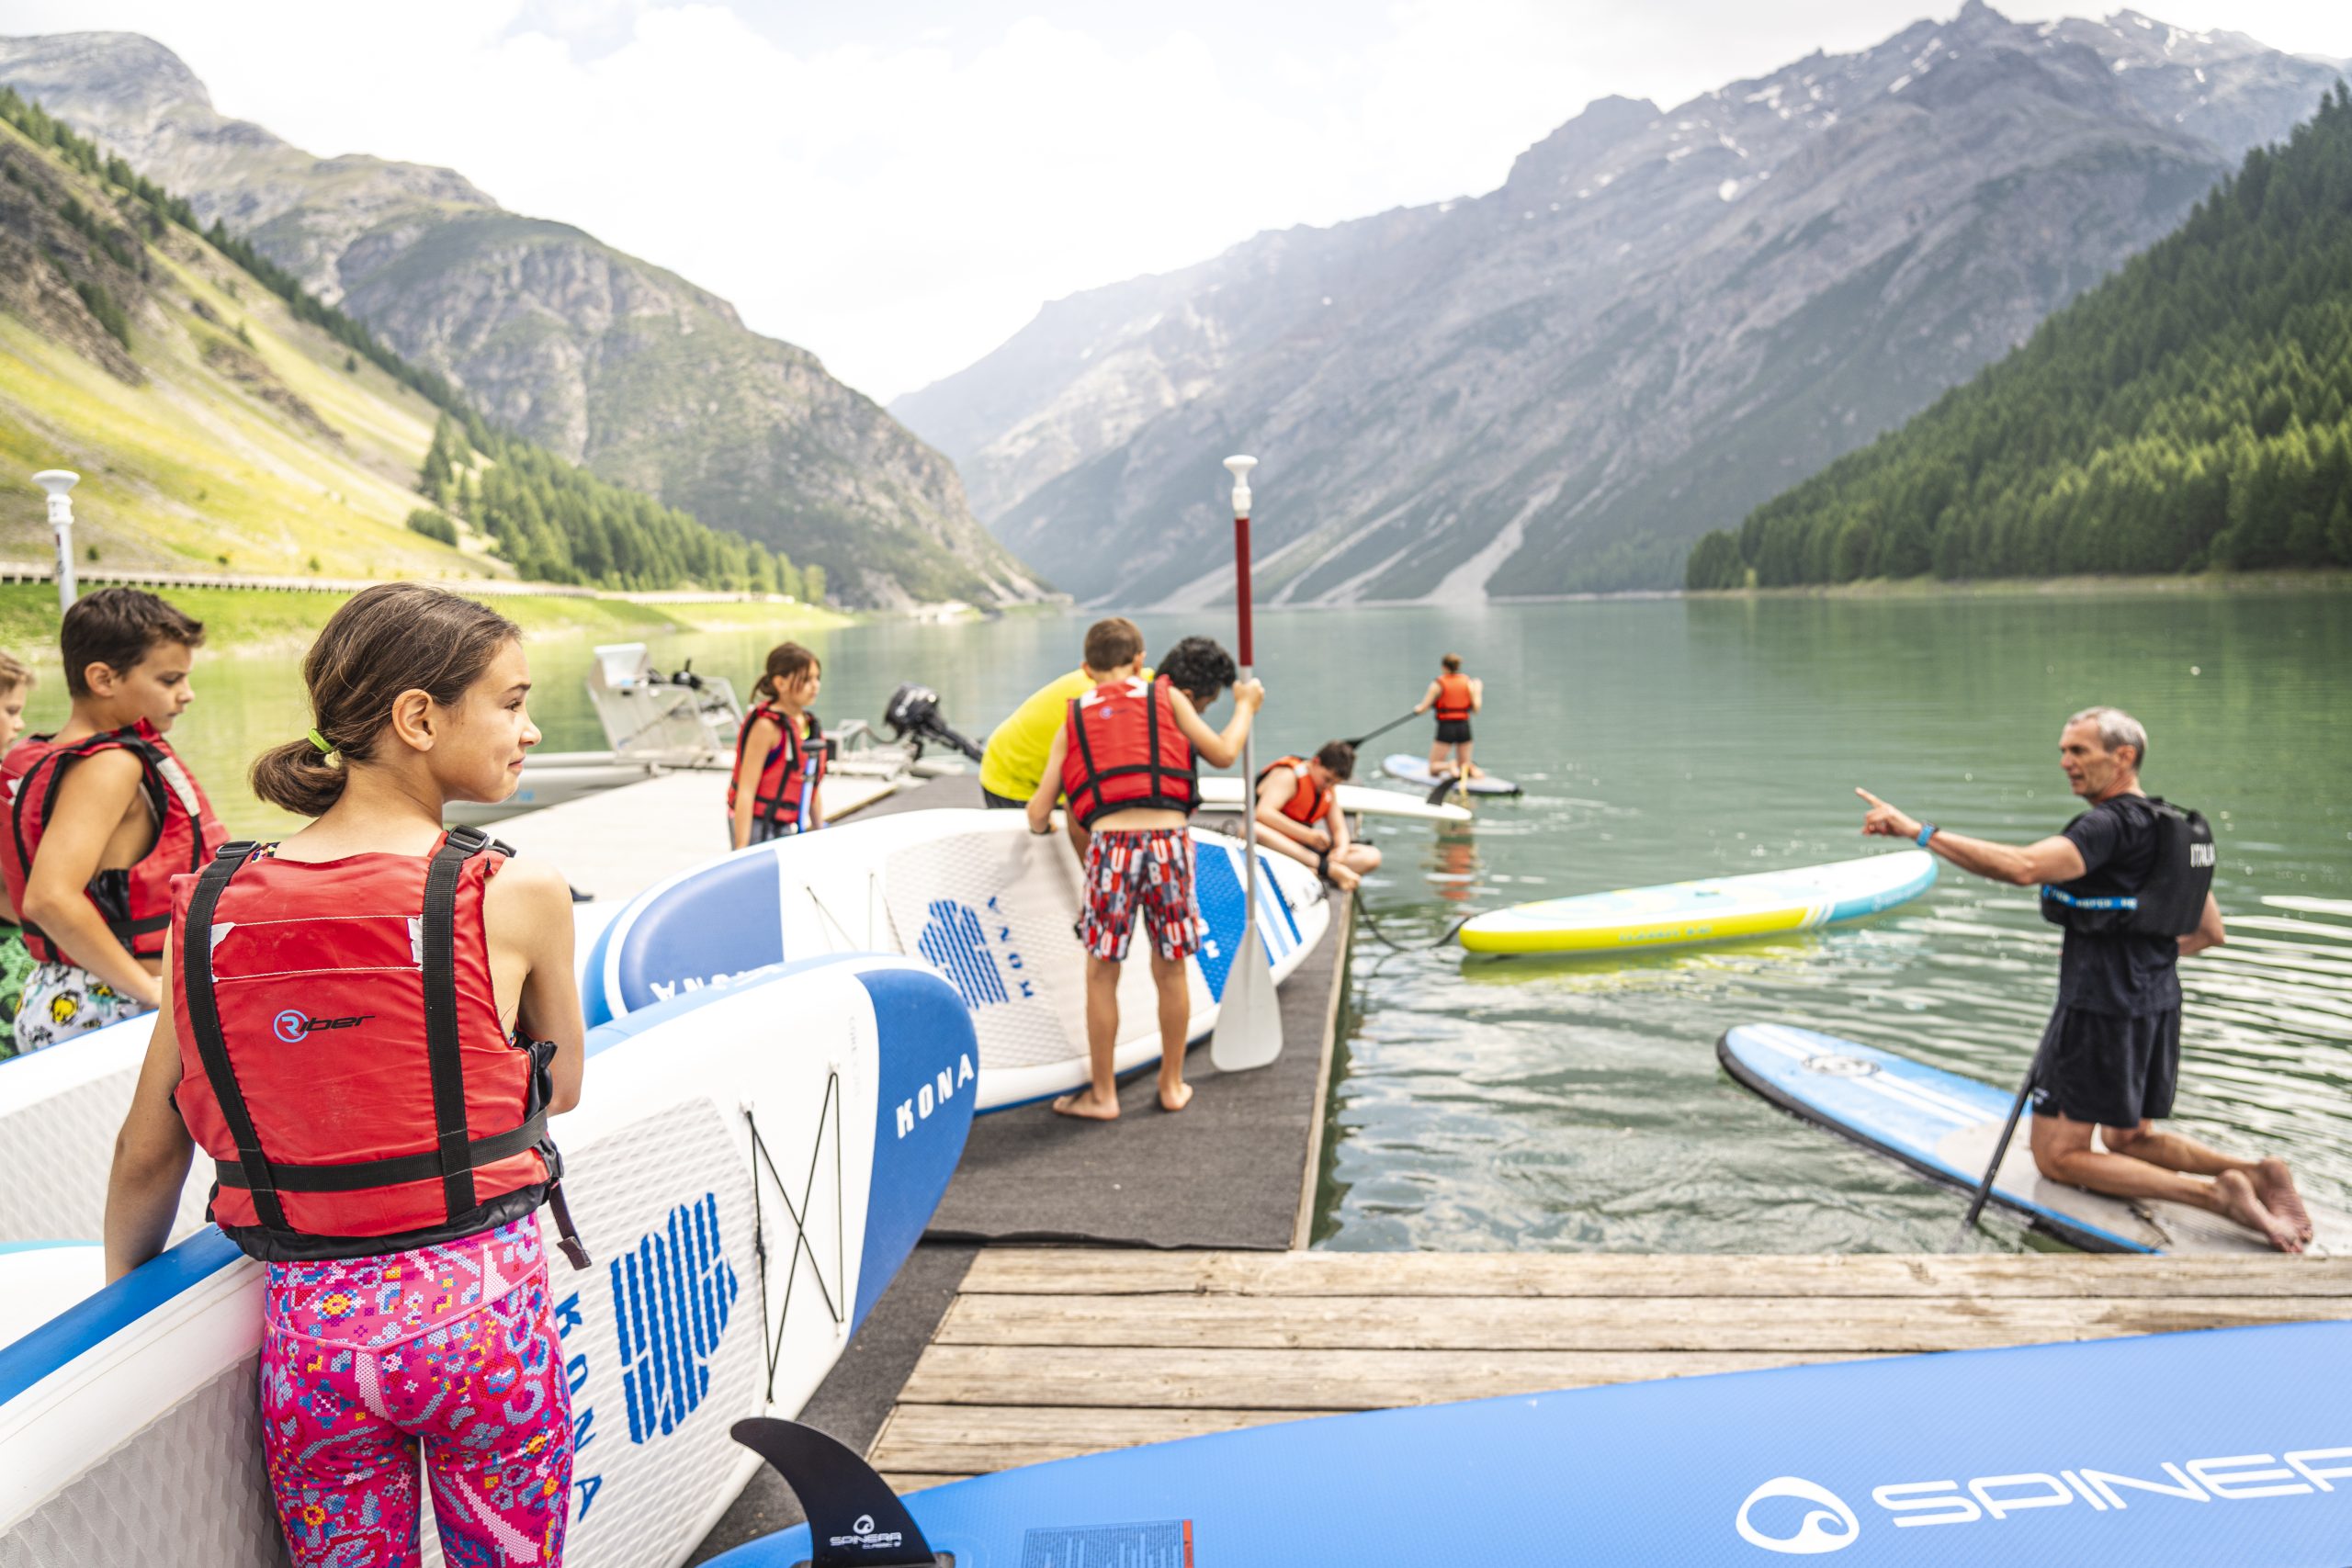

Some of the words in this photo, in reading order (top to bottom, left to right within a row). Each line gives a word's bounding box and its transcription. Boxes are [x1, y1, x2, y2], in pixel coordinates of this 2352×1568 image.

[275, 1010, 375, 1042] Riber
[896, 1053, 975, 1139] KONA
[555, 1291, 603, 1523] KONA
